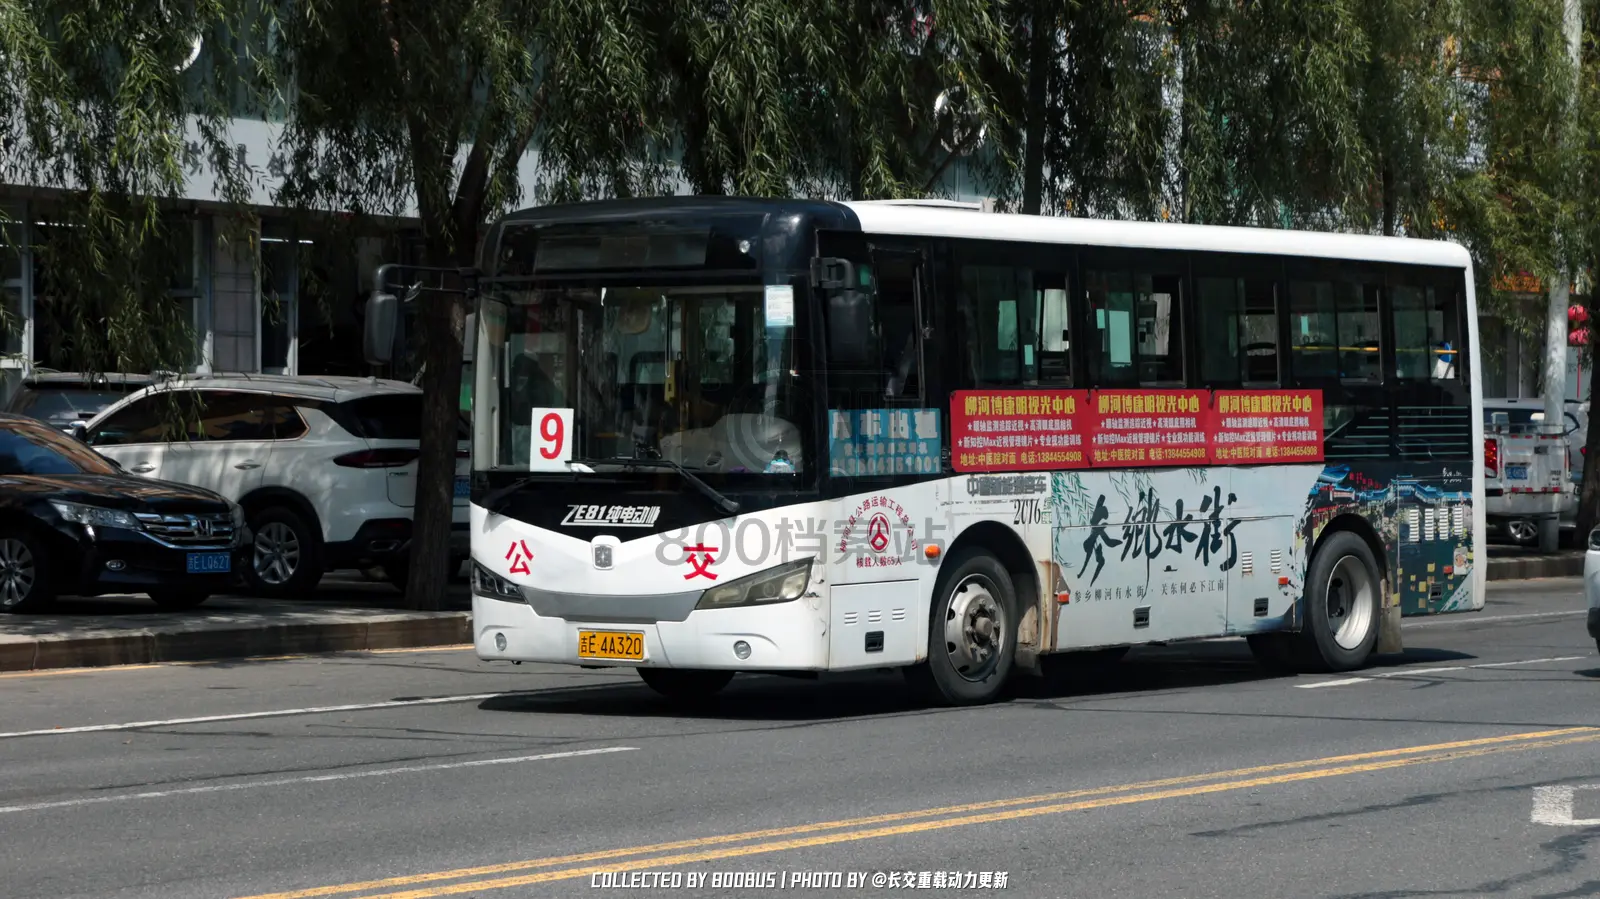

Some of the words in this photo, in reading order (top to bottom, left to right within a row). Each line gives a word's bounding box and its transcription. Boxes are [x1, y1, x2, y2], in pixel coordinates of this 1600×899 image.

[964, 395, 1076, 416] 柳河博康明视光中心
[1098, 395, 1200, 414] 柳河博康明视光中心
[539, 412, 564, 460] 9
[505, 539, 534, 576] 公
[683, 542, 719, 581] 交
